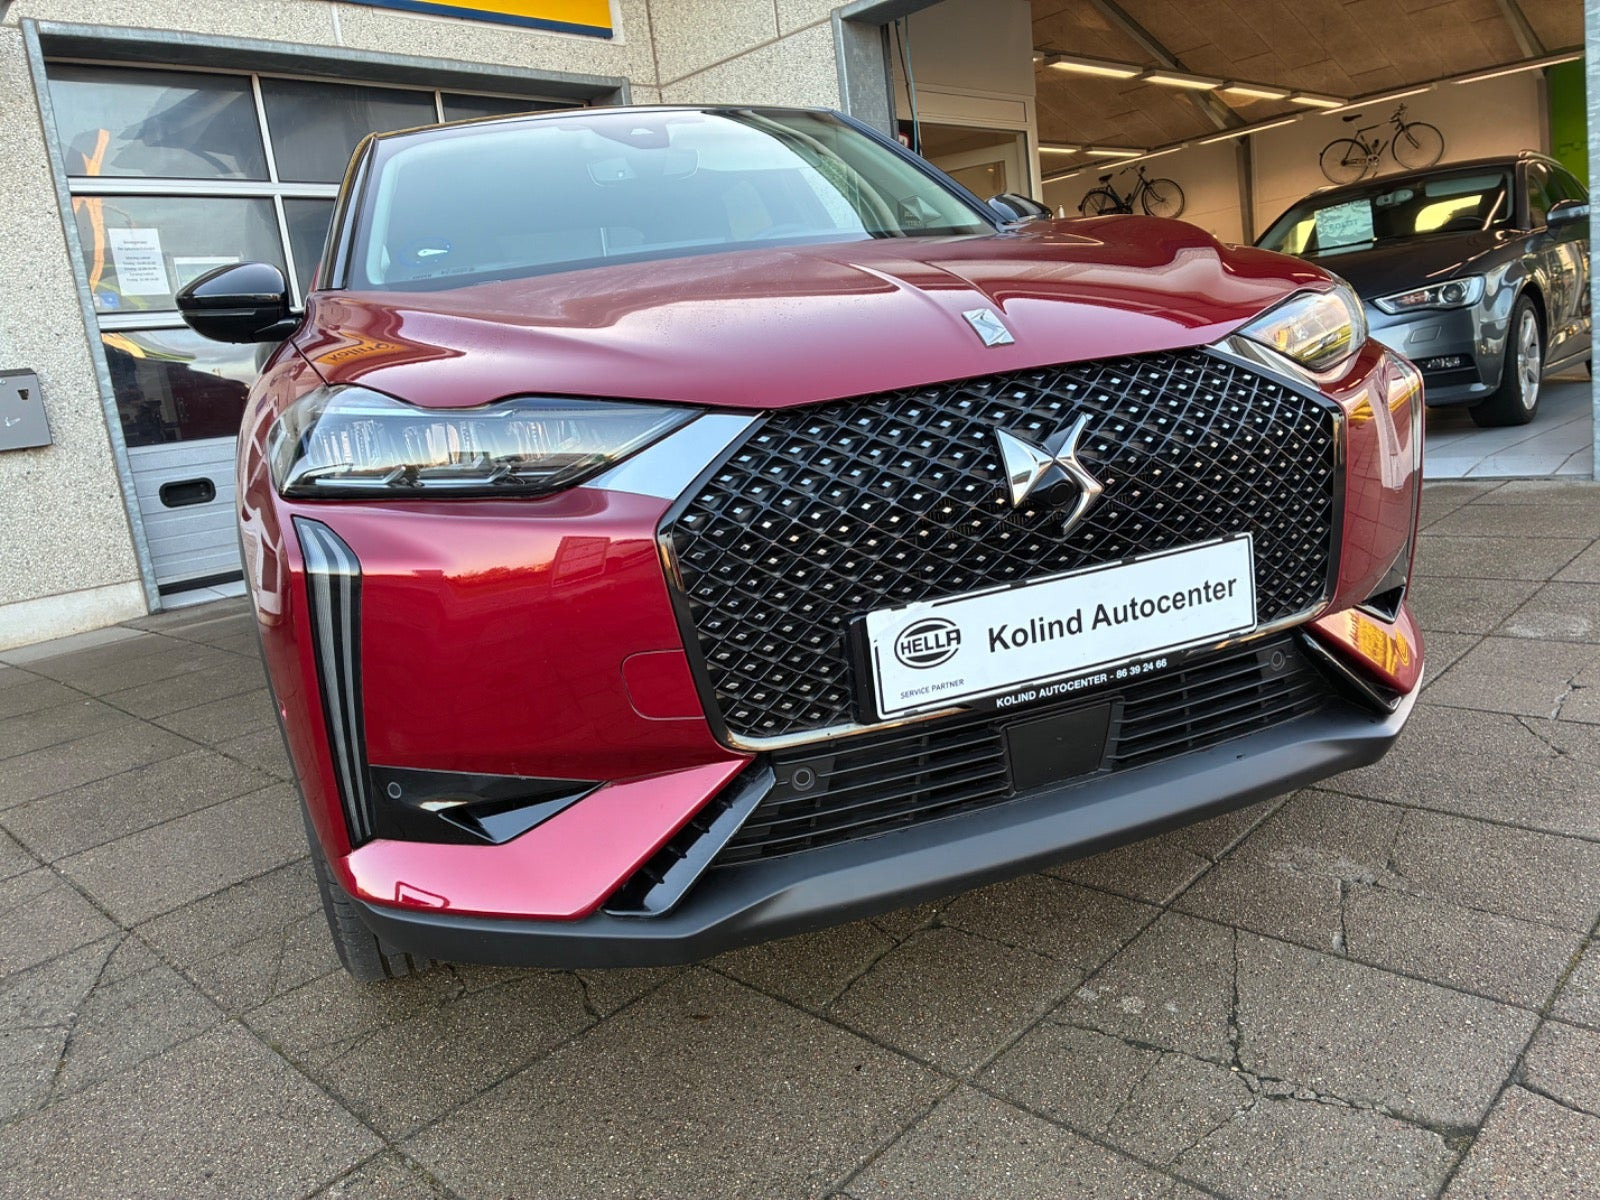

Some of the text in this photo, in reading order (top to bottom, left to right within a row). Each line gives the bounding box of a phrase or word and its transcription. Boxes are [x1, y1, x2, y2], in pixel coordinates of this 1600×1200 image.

[988, 577, 1237, 653] Kolind Autocenter
[900, 628, 962, 656] HELLA
[900, 678, 965, 700] SERVICE PARTNER
[996, 690, 1037, 708] KOLIND
[1039, 672, 1108, 698] AUTOCENTER
[1116, 667, 1128, 679] 86
[1129, 664, 1142, 677] 39
[1143, 661, 1155, 674] 24
[1156, 657, 1168, 669] 66
